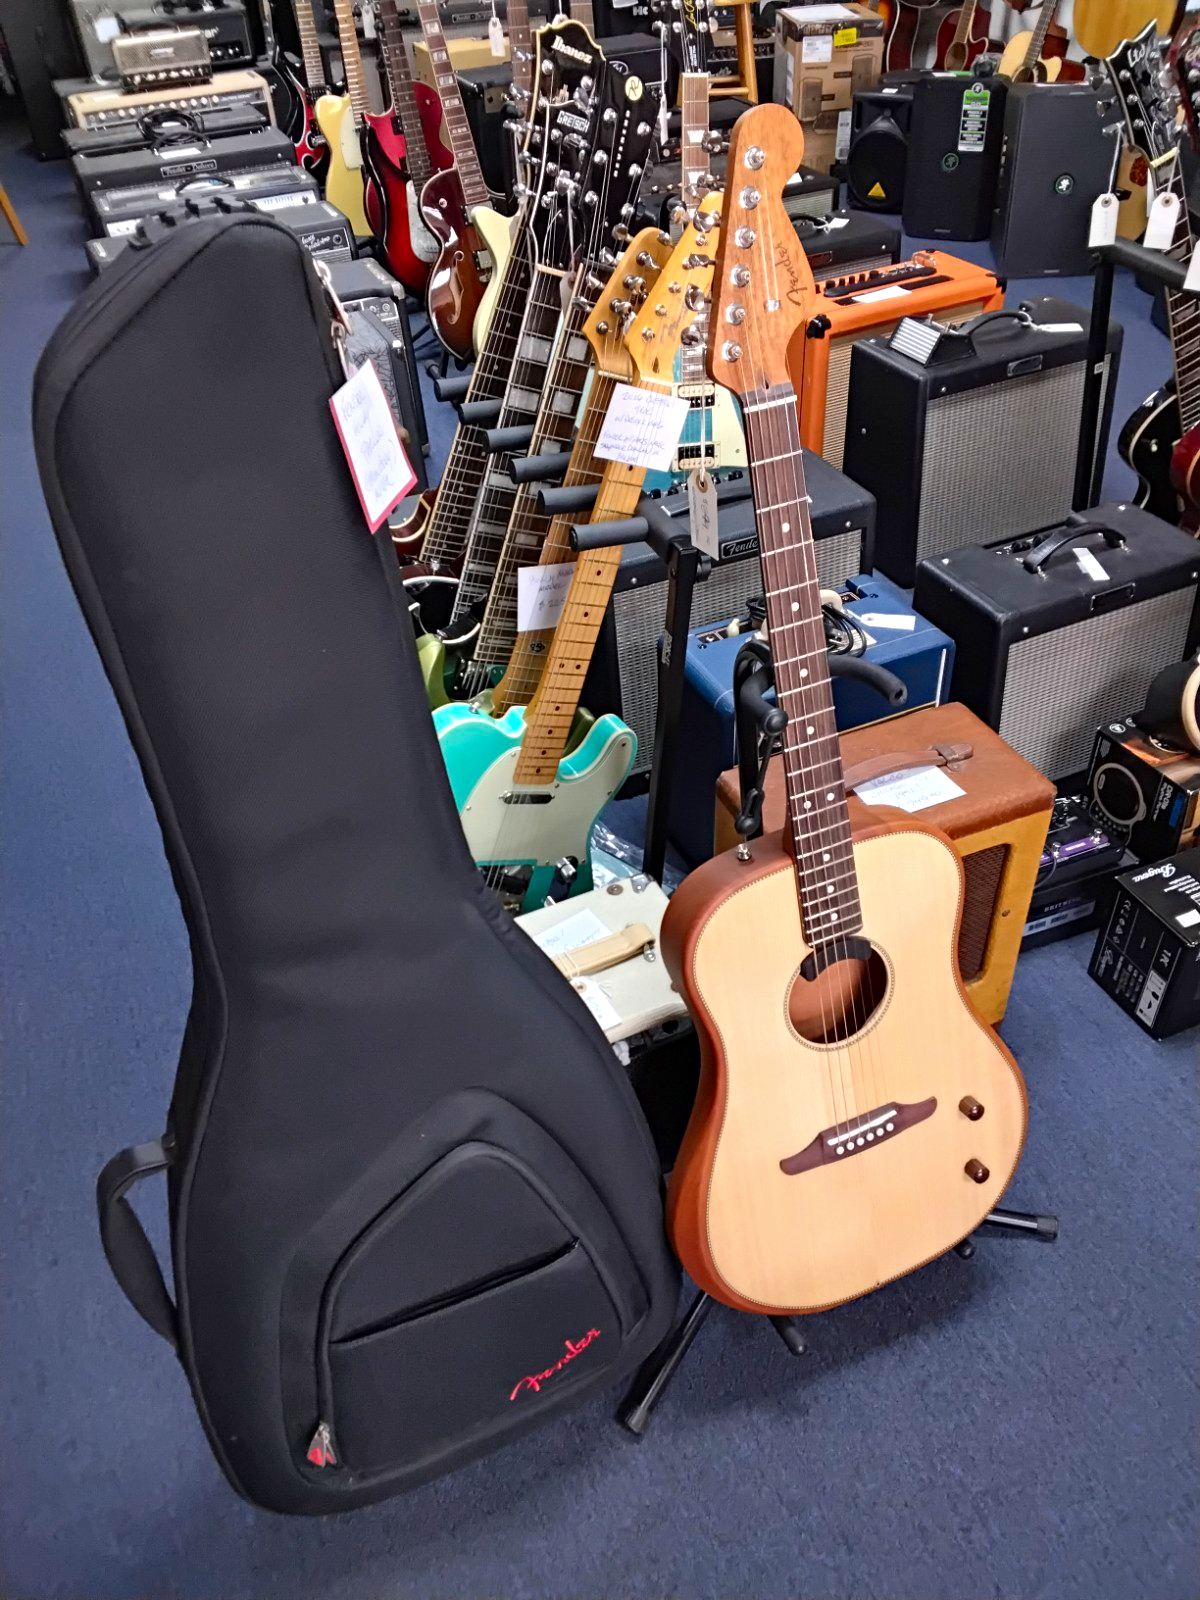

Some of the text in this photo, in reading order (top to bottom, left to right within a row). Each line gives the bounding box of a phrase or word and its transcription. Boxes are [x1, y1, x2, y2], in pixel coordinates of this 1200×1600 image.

[551, 34, 593, 65] Ibanez
[556, 110, 591, 133] GRETSCH
[775, 240, 808, 306] Fender
[726, 537, 759, 556] Fende
[1132, 863, 1176, 883] Bugera
[509, 1328, 601, 1401] Fender
